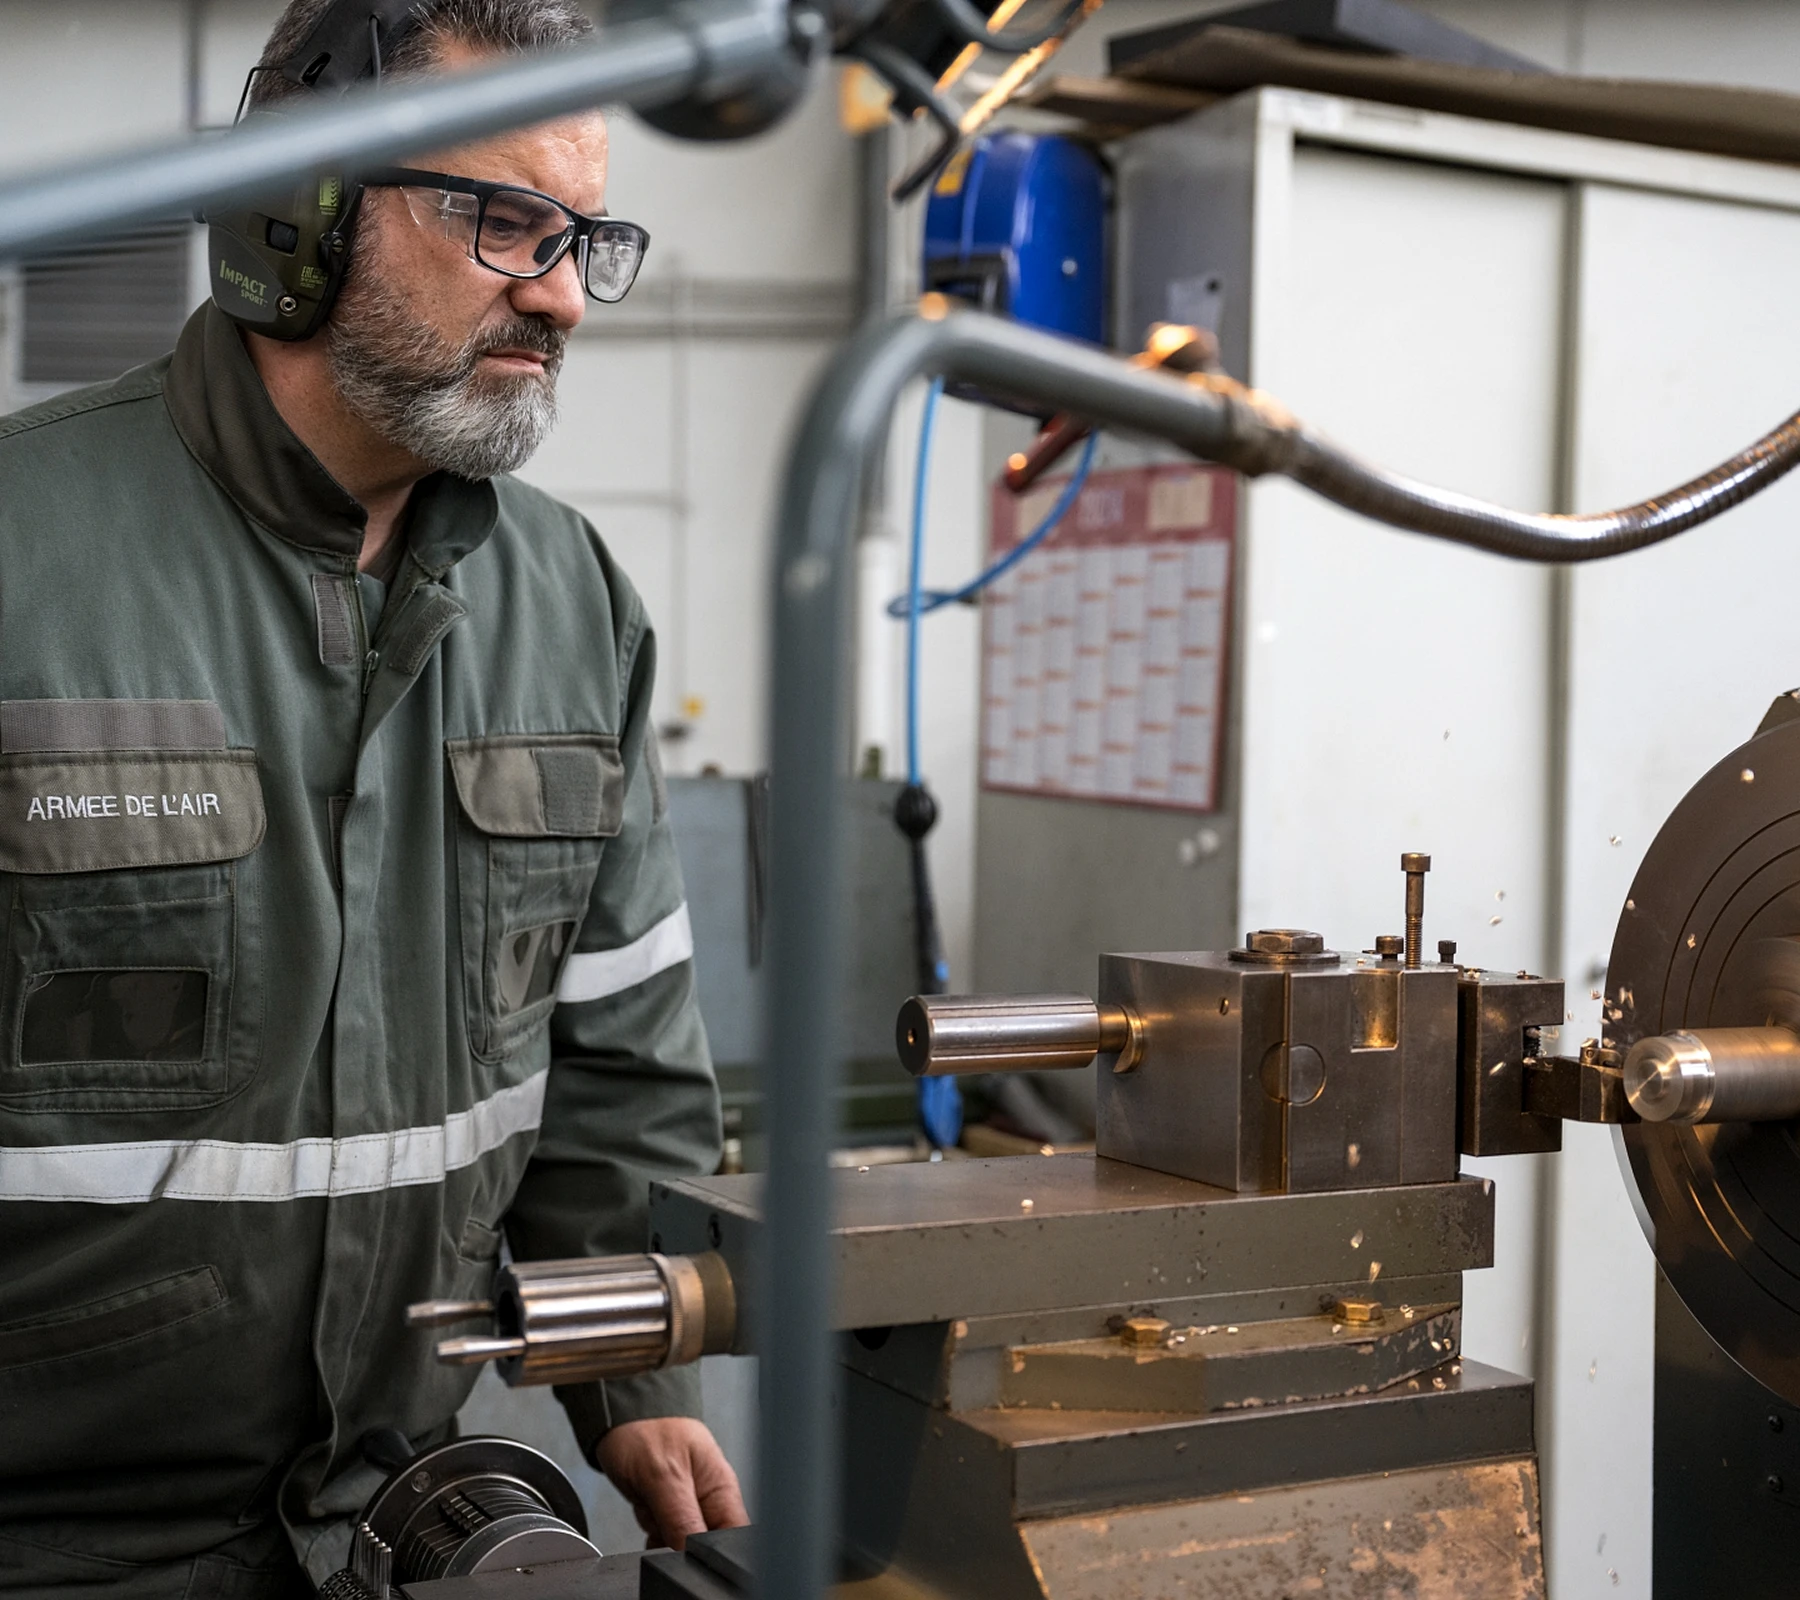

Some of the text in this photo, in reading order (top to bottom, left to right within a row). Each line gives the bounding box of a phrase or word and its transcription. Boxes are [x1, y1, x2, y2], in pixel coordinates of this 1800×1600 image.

[220, 260, 267, 297] IMPACT
[241, 289, 264, 306] SPORT
[26, 793, 222, 822] ARMEE DE L'AIR
